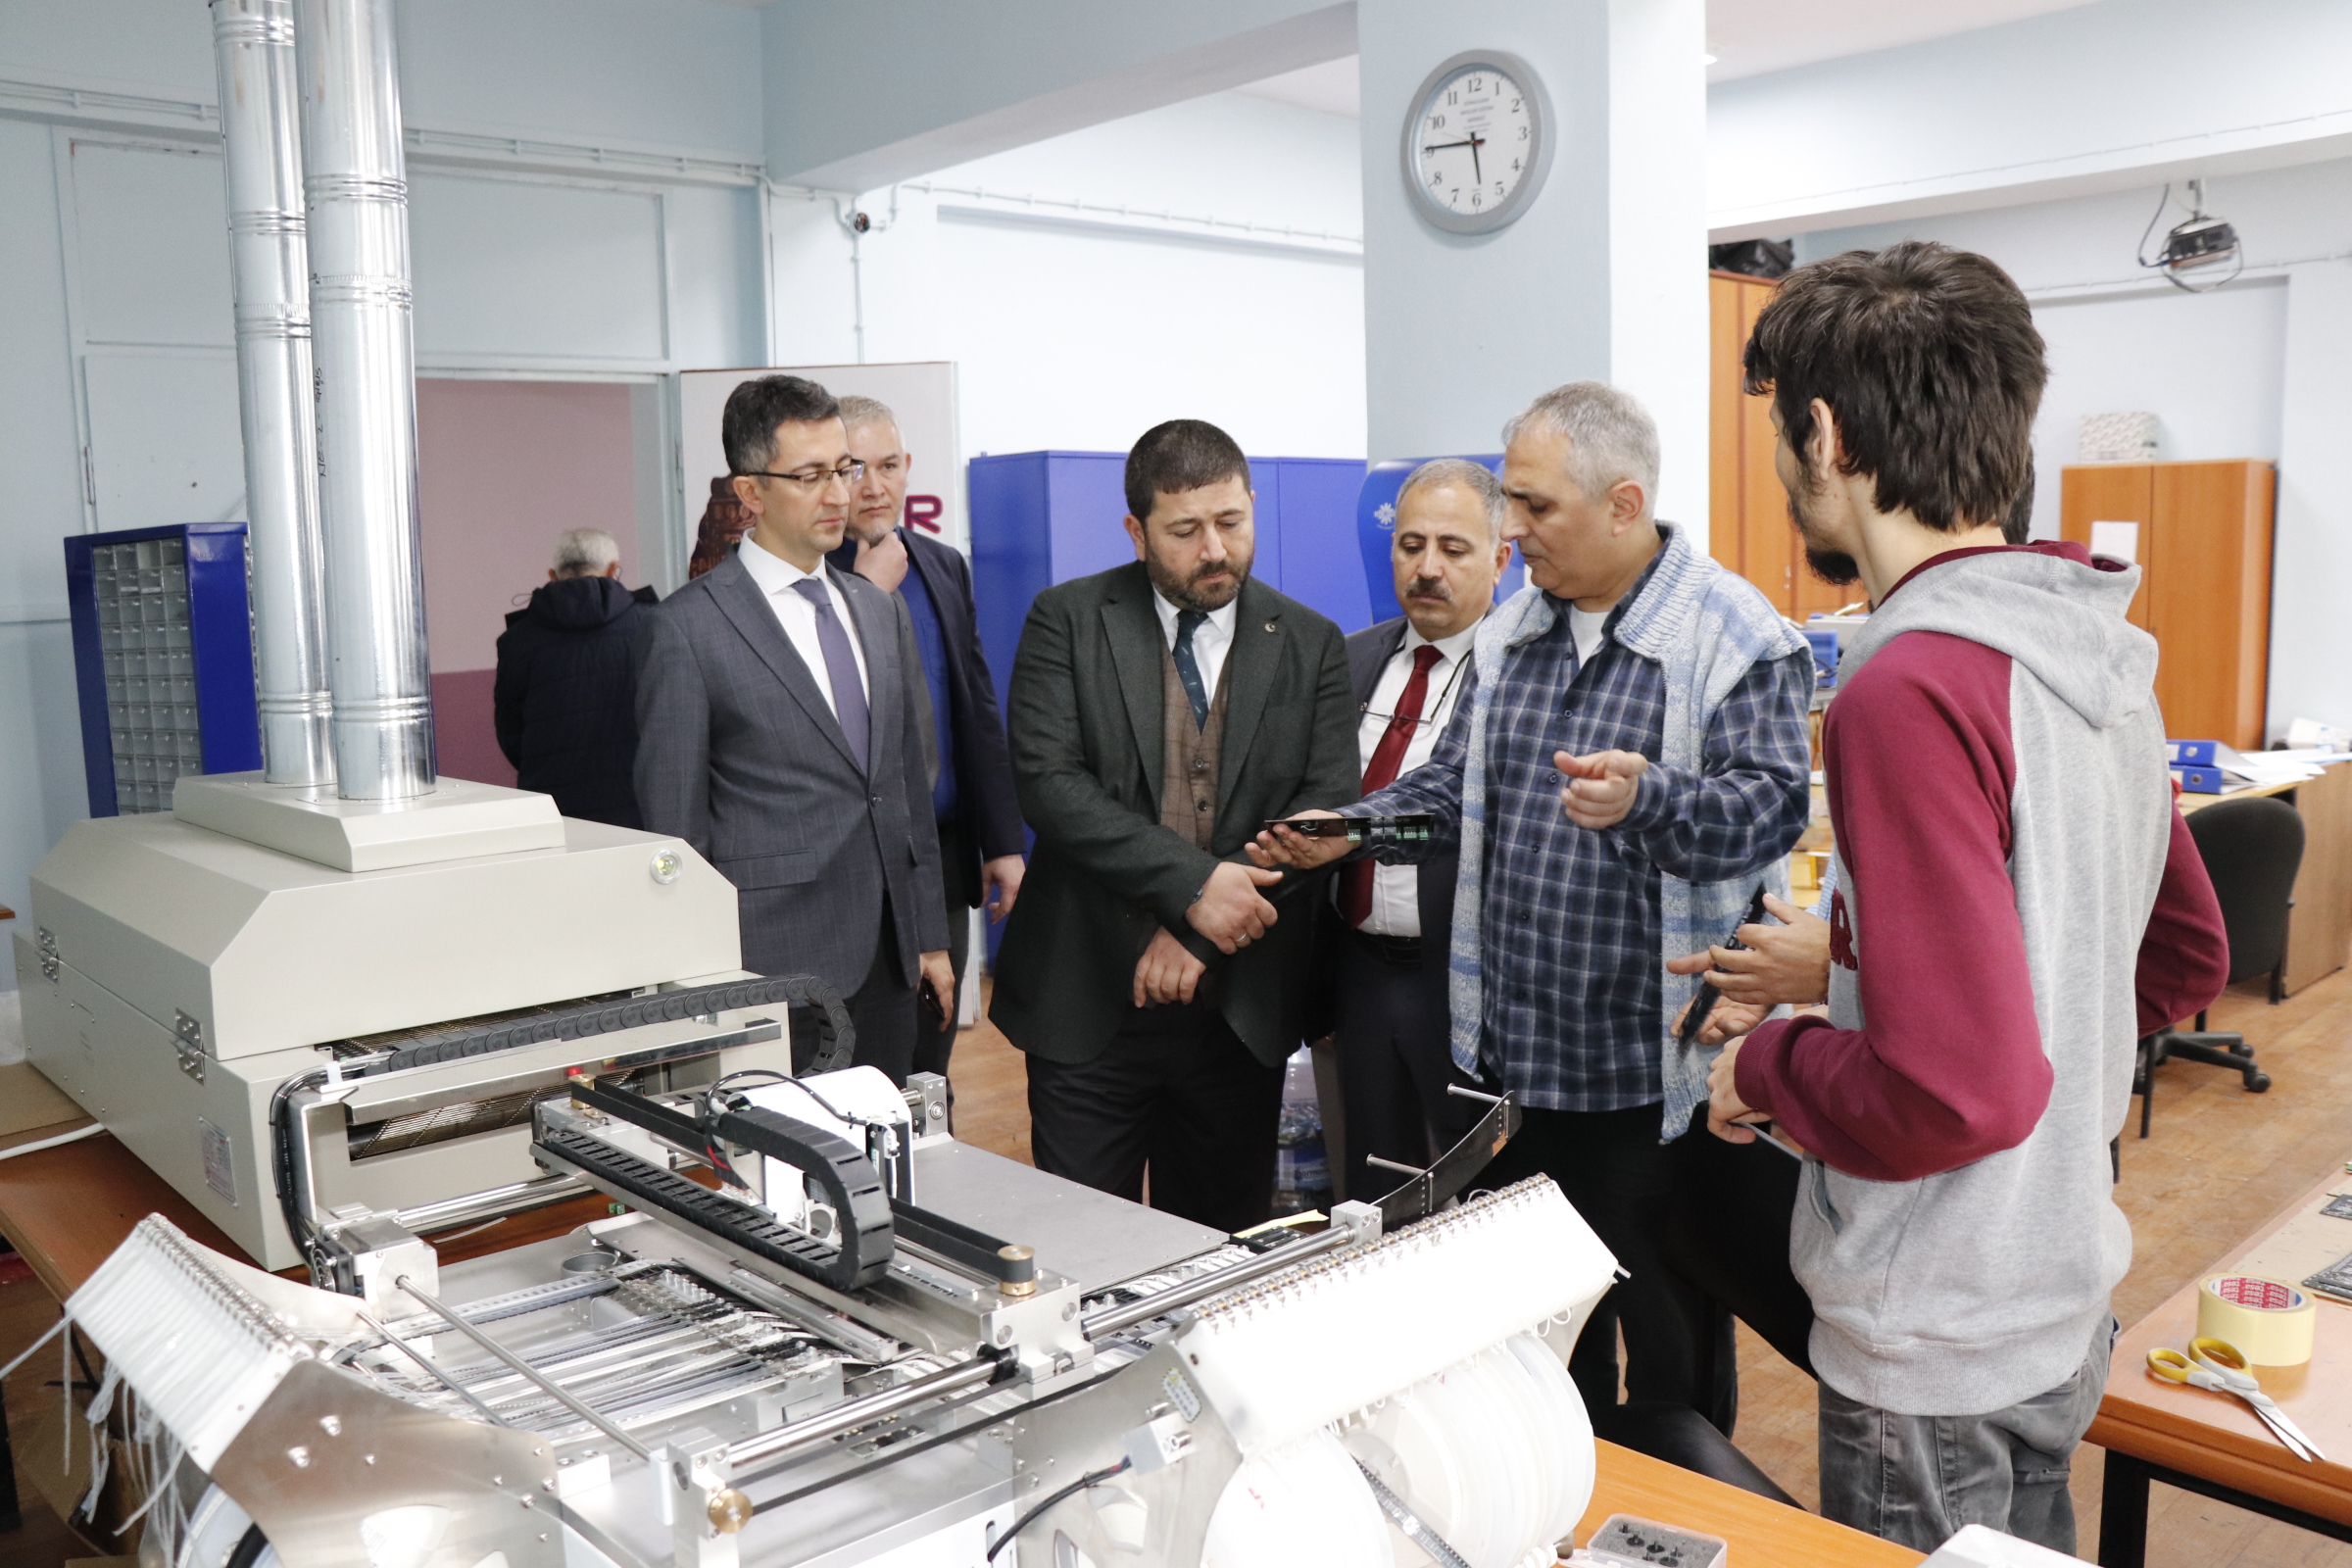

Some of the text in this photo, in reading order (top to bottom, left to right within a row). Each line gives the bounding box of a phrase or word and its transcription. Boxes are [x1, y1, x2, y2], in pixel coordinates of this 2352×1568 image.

[1468, 77, 1482, 93] 12
[1494, 81, 1500, 96] 1
[1447, 90, 1458, 106] 11
[1511, 98, 1520, 113] 2
[1432, 115, 1446, 129] 10
[1519, 127, 1528, 141] 3
[1511, 157, 1521, 172] 4
[1434, 171, 1443, 185] 8
[1450, 188, 1459, 203] 7
[1495, 181, 1504, 196] 5
[1472, 192, 1482, 207] 6
[2270, 1292, 2286, 1300] tesa
[2271, 1285, 2287, 1295] tesa
[2269, 1298, 2286, 1306] tesa
